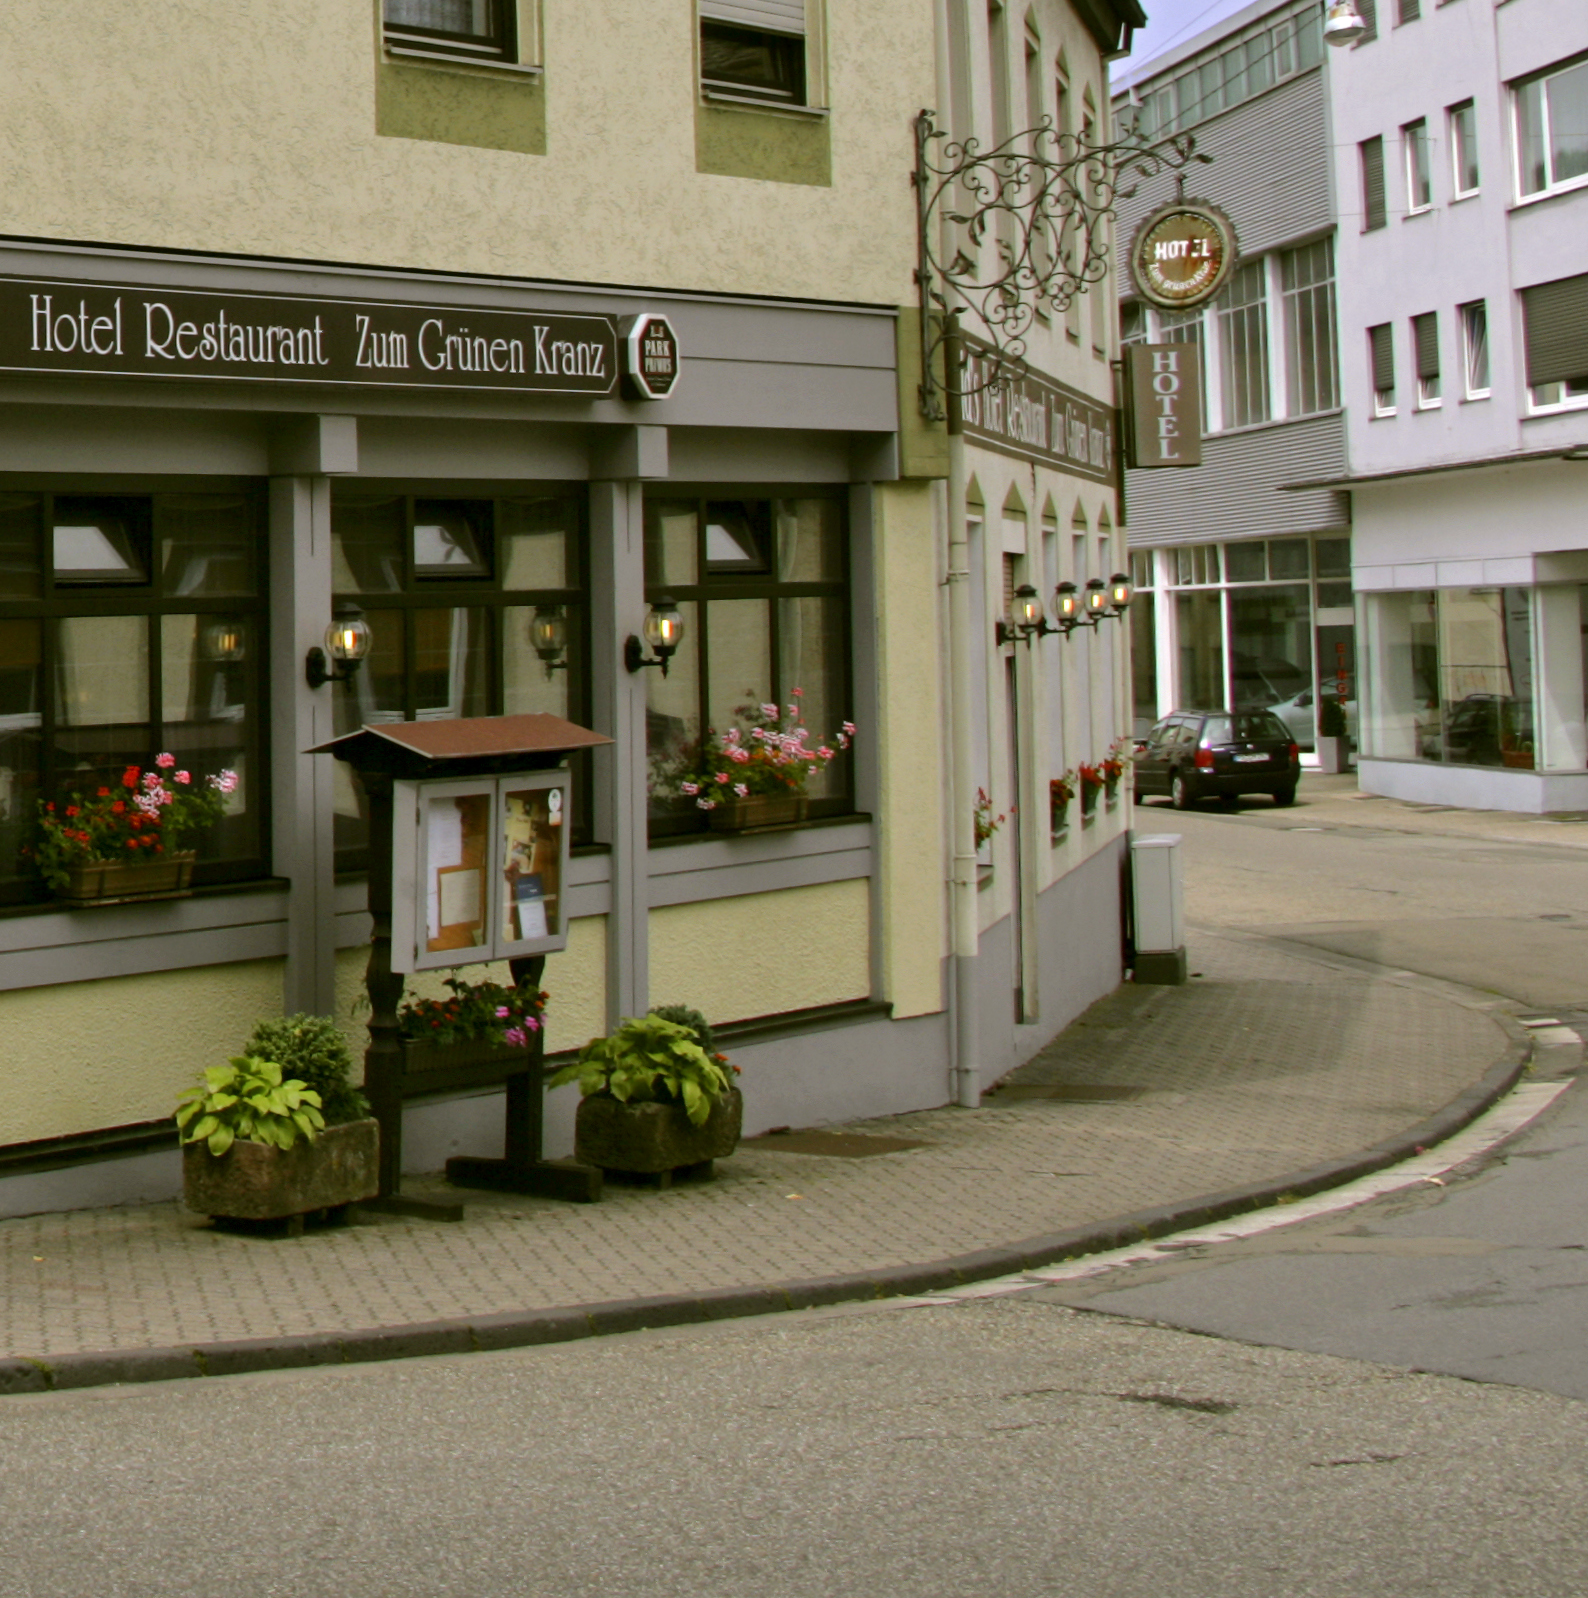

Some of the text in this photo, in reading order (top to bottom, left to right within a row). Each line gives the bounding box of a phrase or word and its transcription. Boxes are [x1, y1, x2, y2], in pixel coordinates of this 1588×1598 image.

[1154, 238, 1211, 261] HOTEL
[29, 293, 124, 356] Hotel
[142, 302, 330, 367] Restaurant
[355, 313, 410, 369] Zum
[418, 318, 526, 374] Grünen
[532, 325, 606, 379] Kranz
[644, 340, 671, 357] PARK
[1152, 351, 1180, 460] HOTEL
